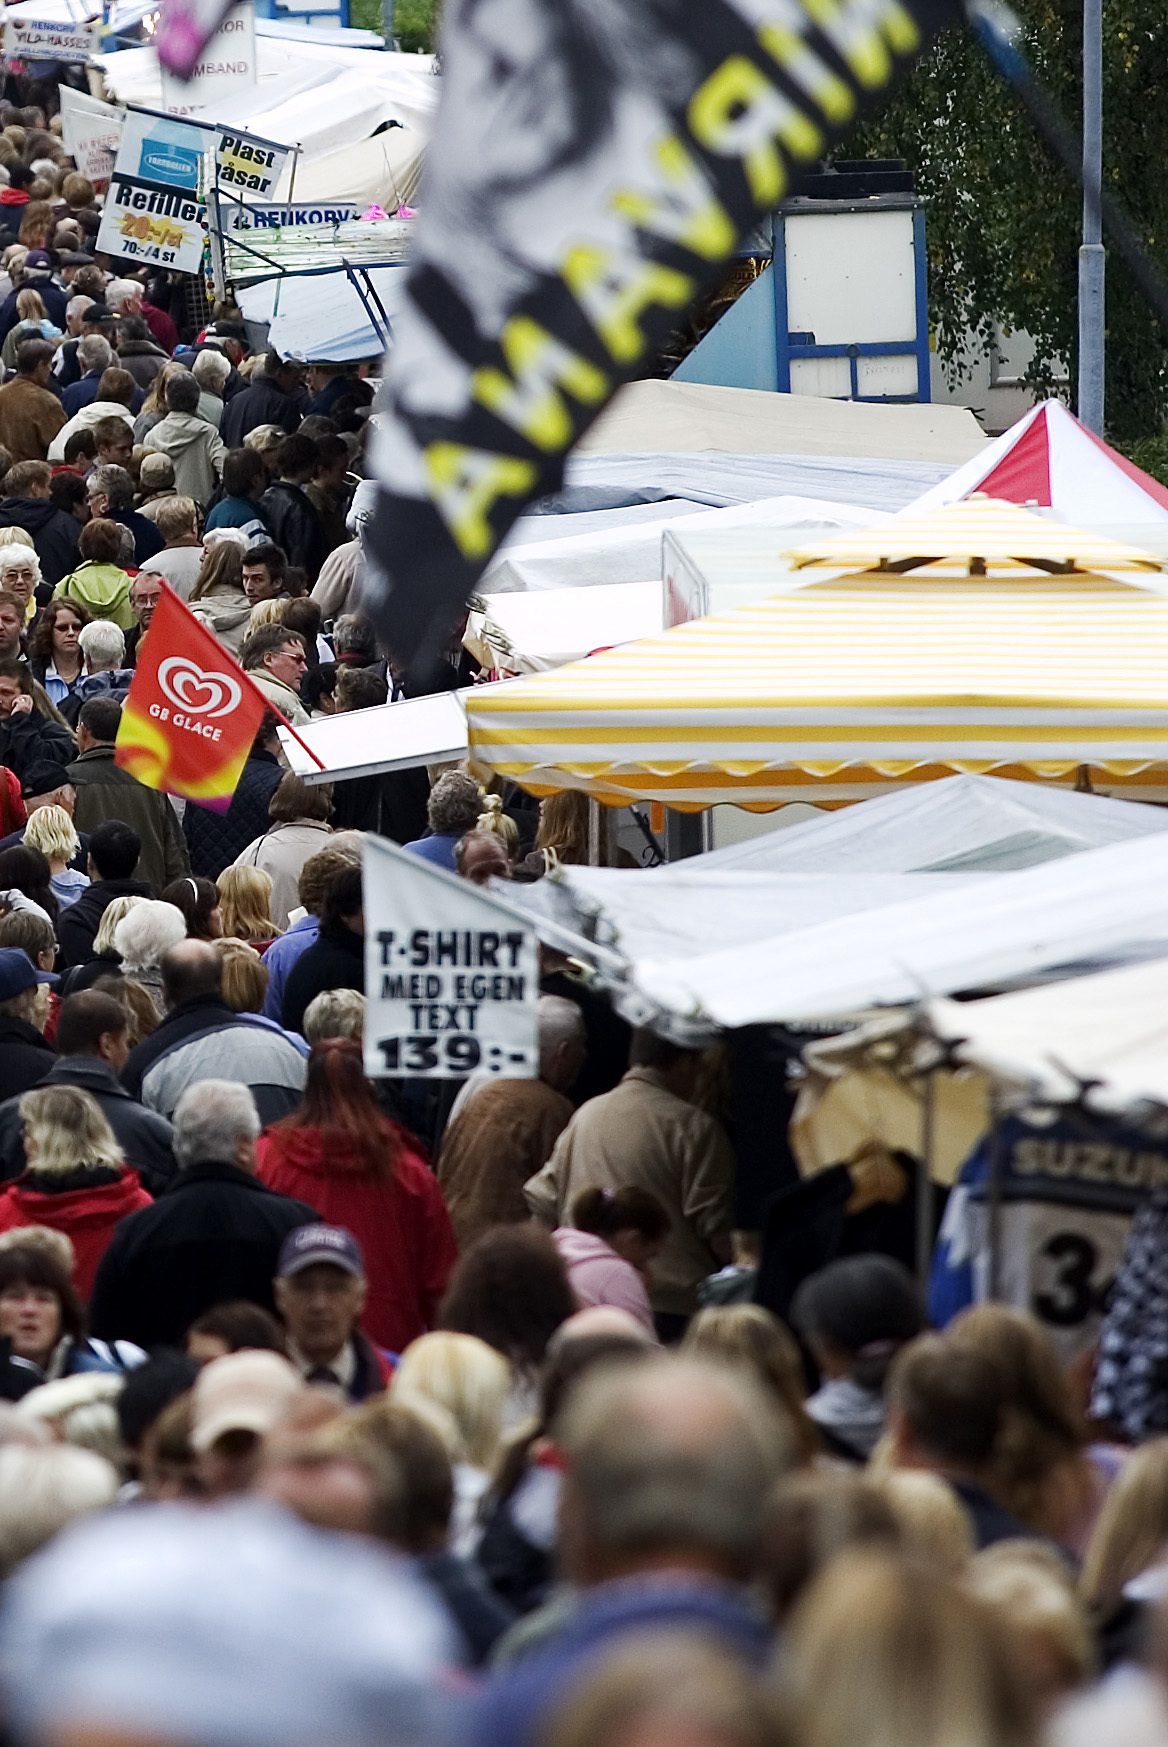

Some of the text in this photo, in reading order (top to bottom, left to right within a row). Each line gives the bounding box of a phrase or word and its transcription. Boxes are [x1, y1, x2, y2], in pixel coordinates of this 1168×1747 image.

[218, 135, 275, 168] Plast
[115, 184, 208, 223] Refiller
[162, 251, 176, 263] st
[149, 703, 223, 741] GB GLACE
[377, 930, 524, 967] T-SHIRT
[382, 974, 525, 1001] MED EGEN
[409, 1004, 479, 1030] TEXT
[377, 1036, 526, 1071] 139:-
